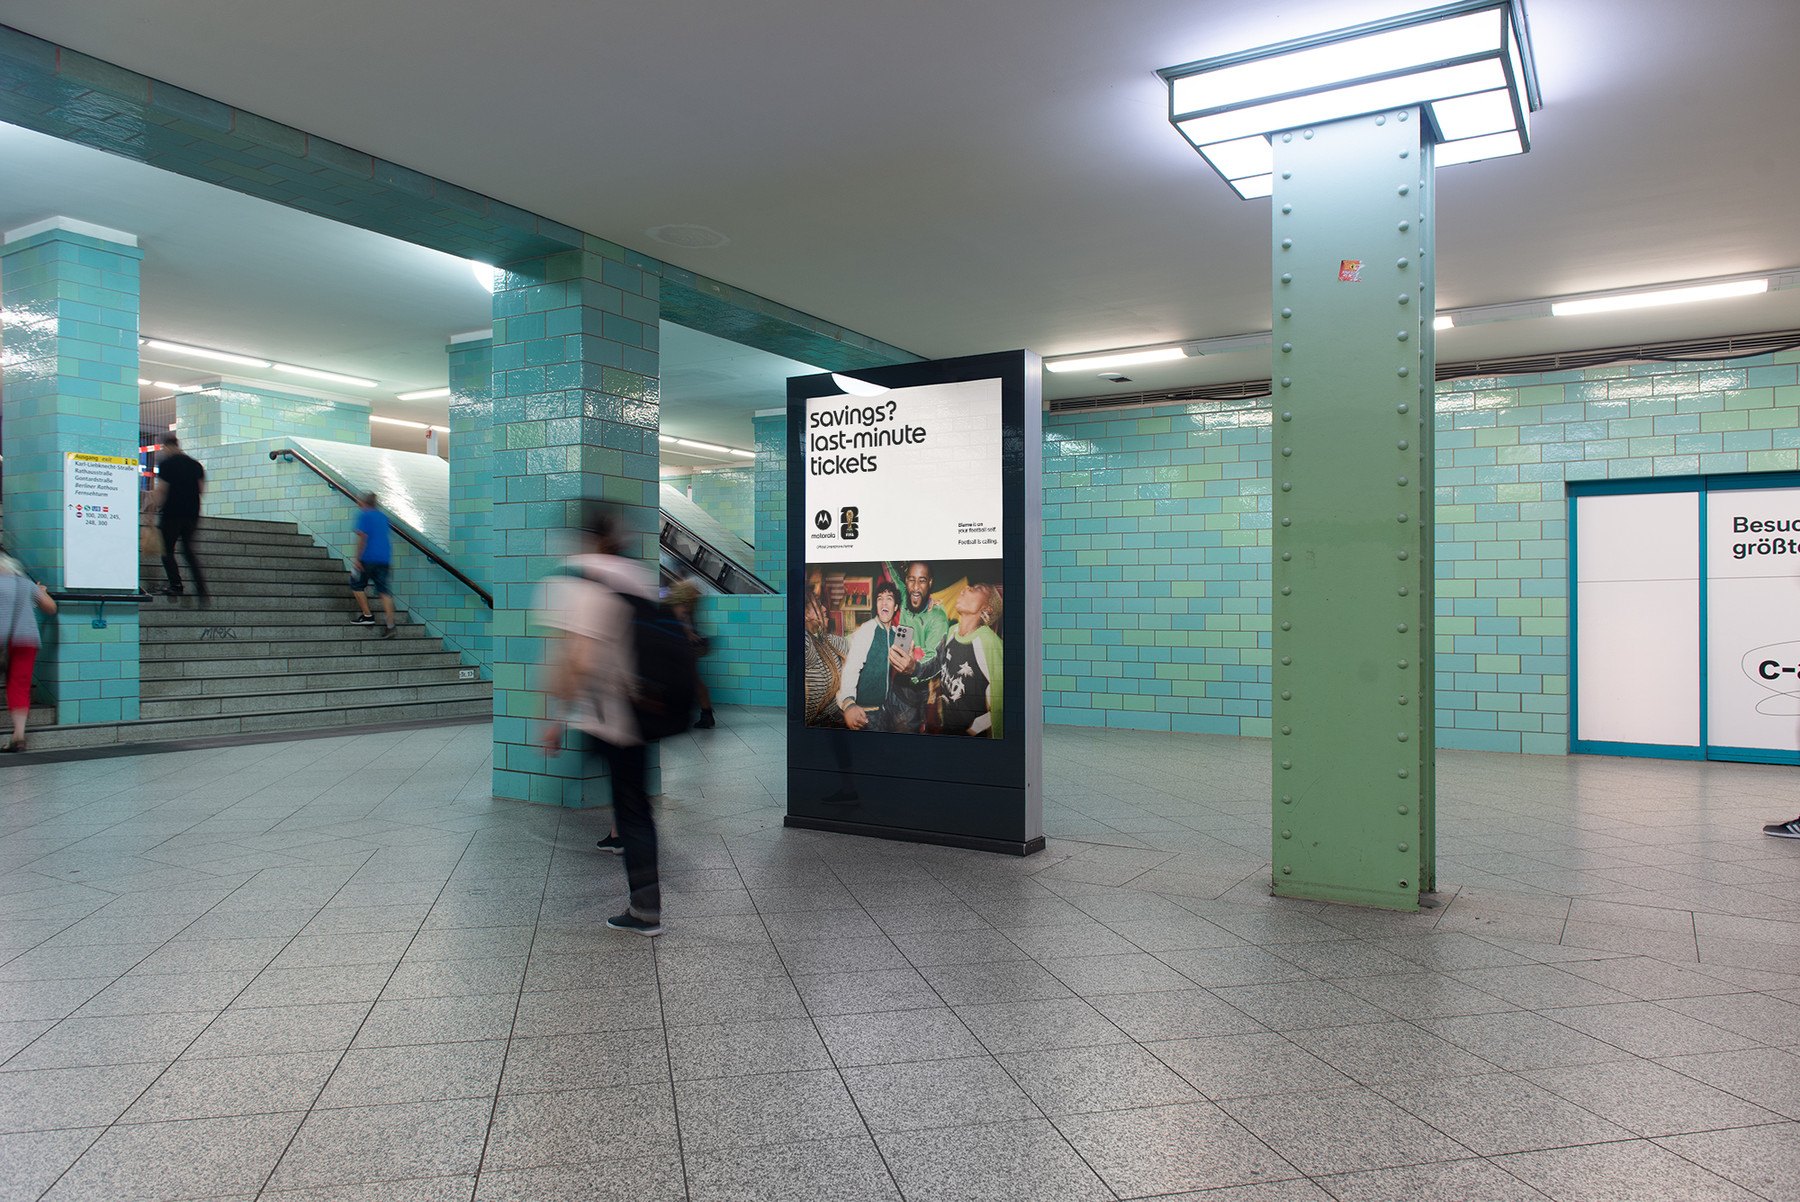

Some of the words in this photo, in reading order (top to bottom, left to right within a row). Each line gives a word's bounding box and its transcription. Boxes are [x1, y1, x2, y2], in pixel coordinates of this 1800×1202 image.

[810, 400, 897, 428] savings?
[810, 424, 927, 452] last-minute
[74, 453, 99, 462] Ausgang
[74, 461, 134, 471] Karl-Liebknecht-Straße
[810, 453, 877, 476] tickets
[74, 468, 113, 476] Rathausstraße
[74, 475, 114, 483] Gontardstraße
[1732, 537, 1800, 559] größt
[1758, 660, 1800, 680] c-
